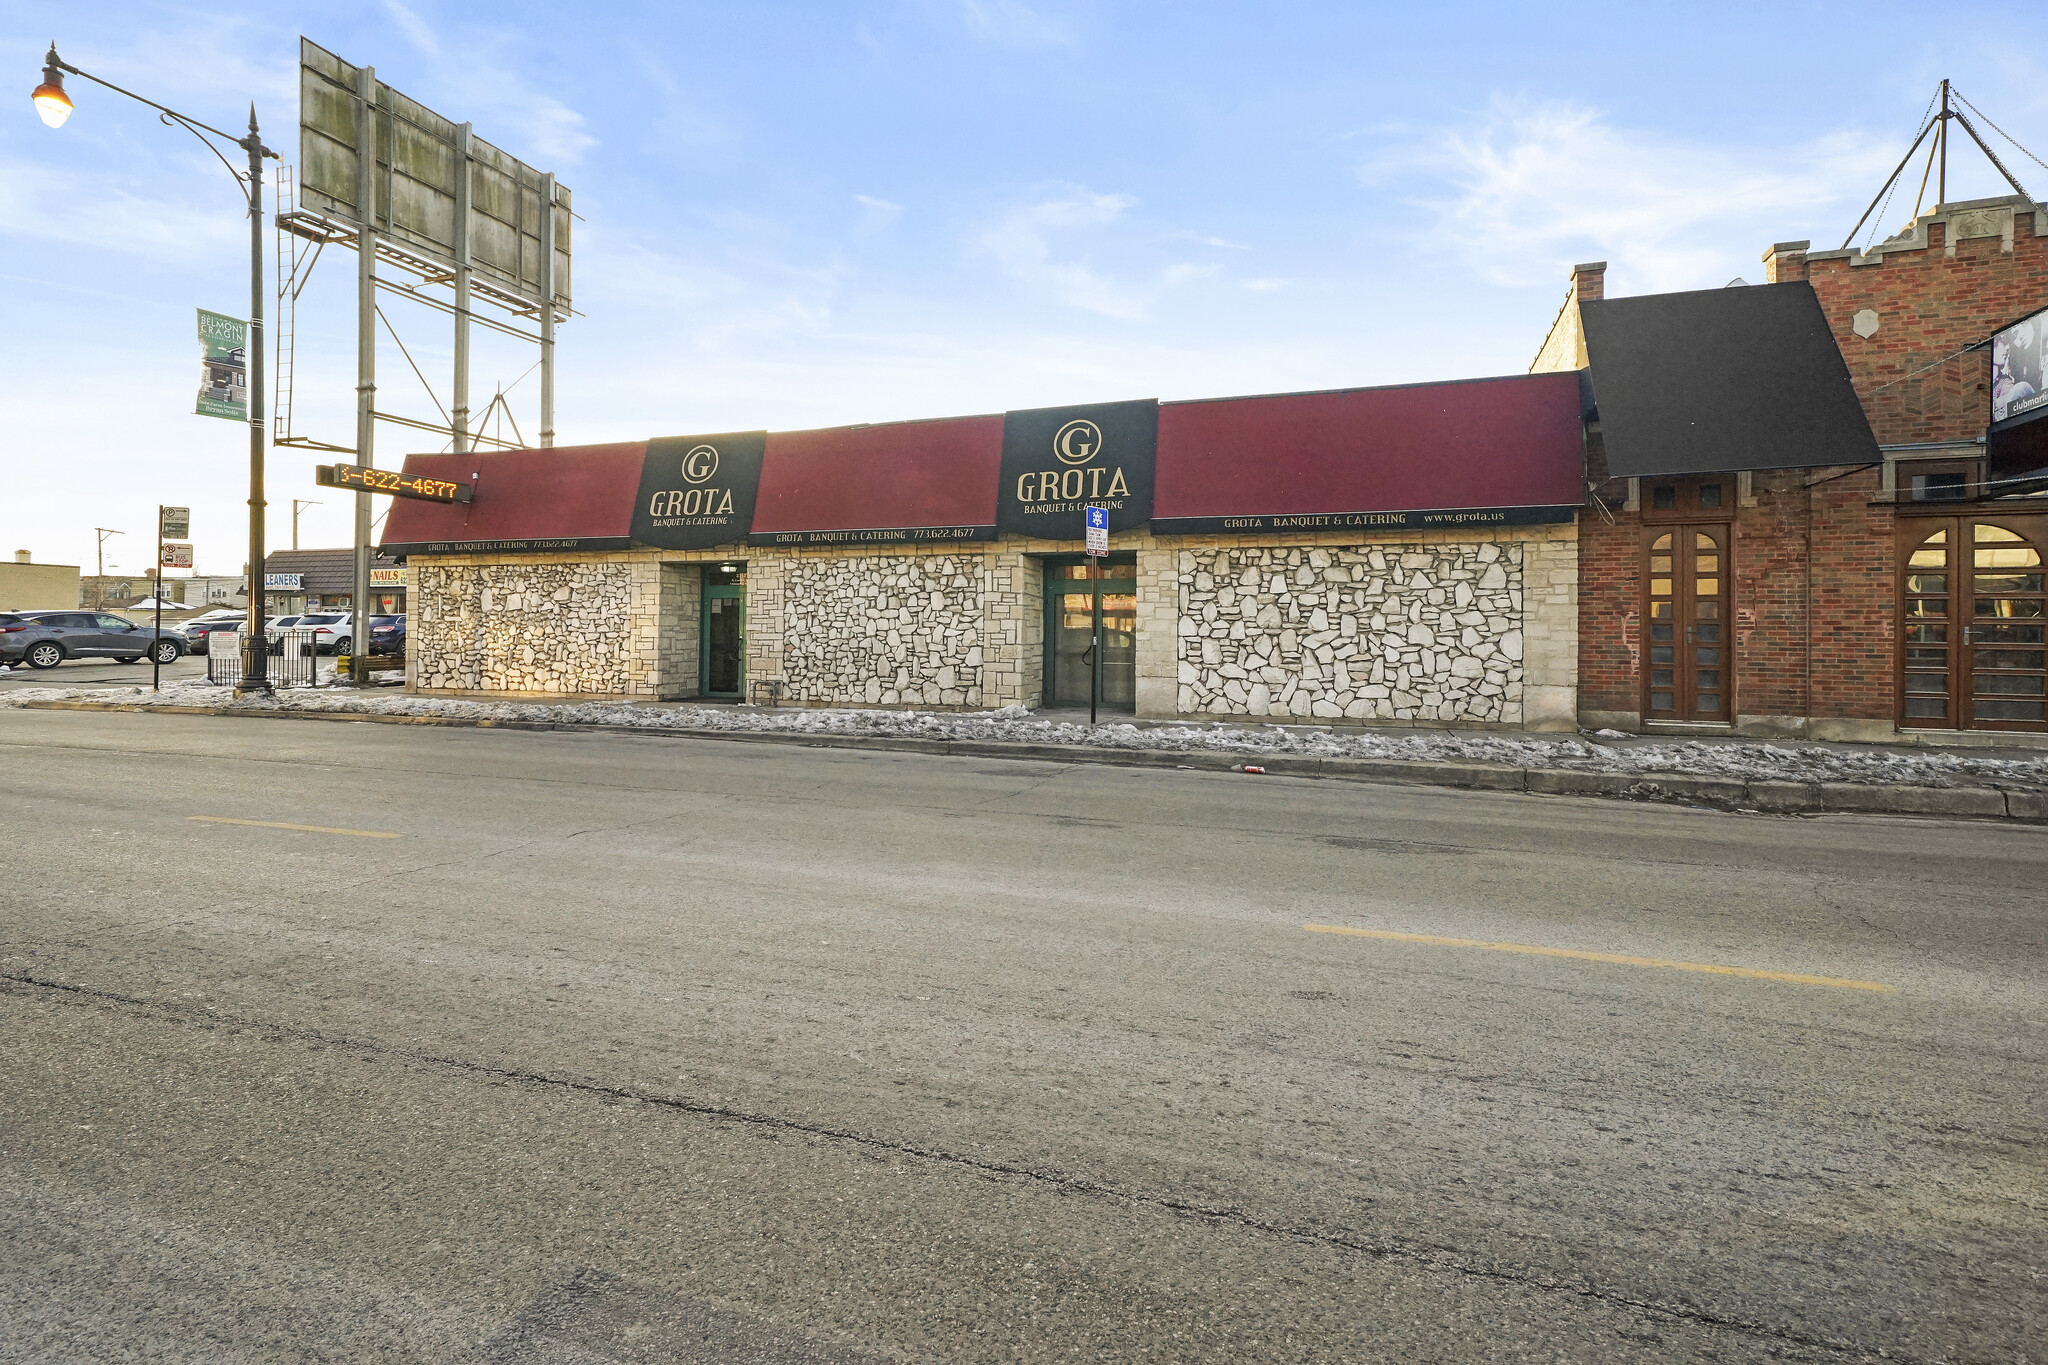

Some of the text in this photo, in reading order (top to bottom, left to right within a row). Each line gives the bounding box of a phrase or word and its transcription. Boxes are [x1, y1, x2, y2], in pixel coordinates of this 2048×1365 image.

[201, 315, 243, 334] BELMONT
[201, 325, 243, 341] CRAGIN
[2013, 391, 2048, 411] clubmarti
[1061, 427, 1092, 457] G
[687, 452, 711, 477] G
[1017, 467, 1131, 502] GROTA
[649, 488, 735, 517] GROTA
[1024, 500, 1123, 514] BANQUET & CATERING
[653, 517, 685, 528] BANQUET
[692, 517, 728, 525] CATERING
[1224, 512, 1505, 528] GROTA BANQUET & CATERING www.grota.us
[776, 529, 975, 543] GROTA BANQUET & CATERING 773.622.4677
[428, 540, 578, 551] GROTA BANQUET & CATERING 773.622.4677
[265, 574, 298, 586] LEANERS
[373, 570, 399, 581] NAILS
